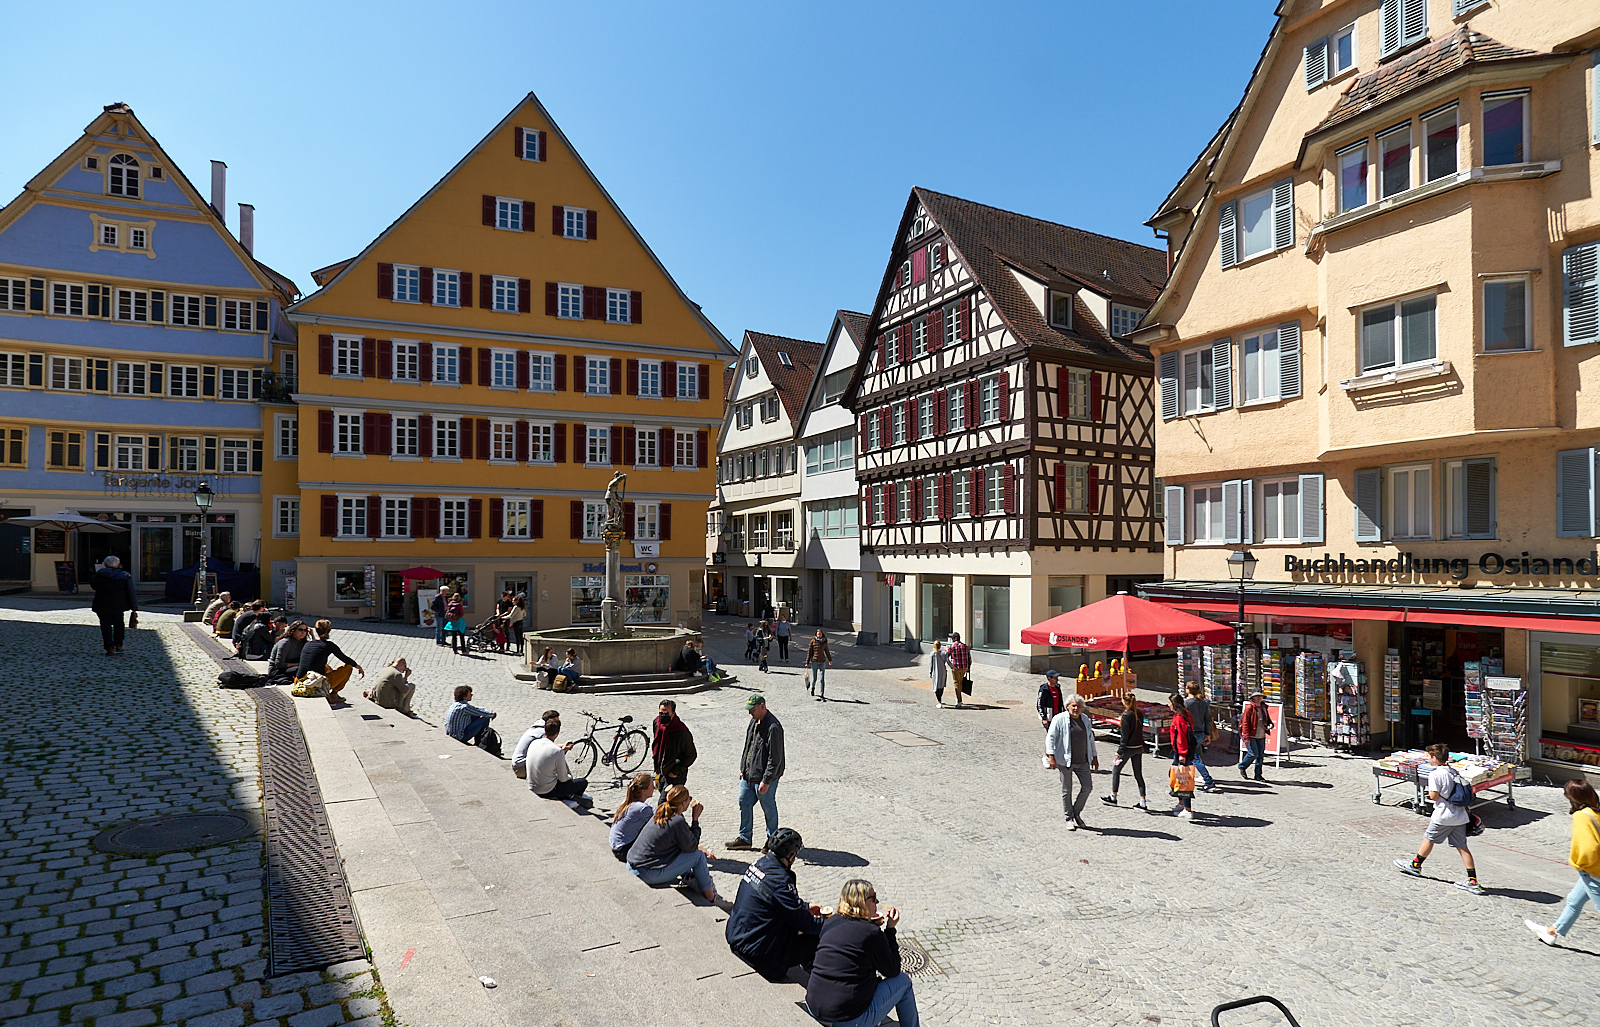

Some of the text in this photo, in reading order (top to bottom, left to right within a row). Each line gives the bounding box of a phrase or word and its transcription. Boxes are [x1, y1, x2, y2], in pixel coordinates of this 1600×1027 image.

[101, 474, 170, 489] Tangente
[1284, 551, 1598, 579] Buchhandlung Osiand
[1058, 635, 1097, 644] OSIANDER.de
[1165, 634, 1205, 642] OSIANDER.de
